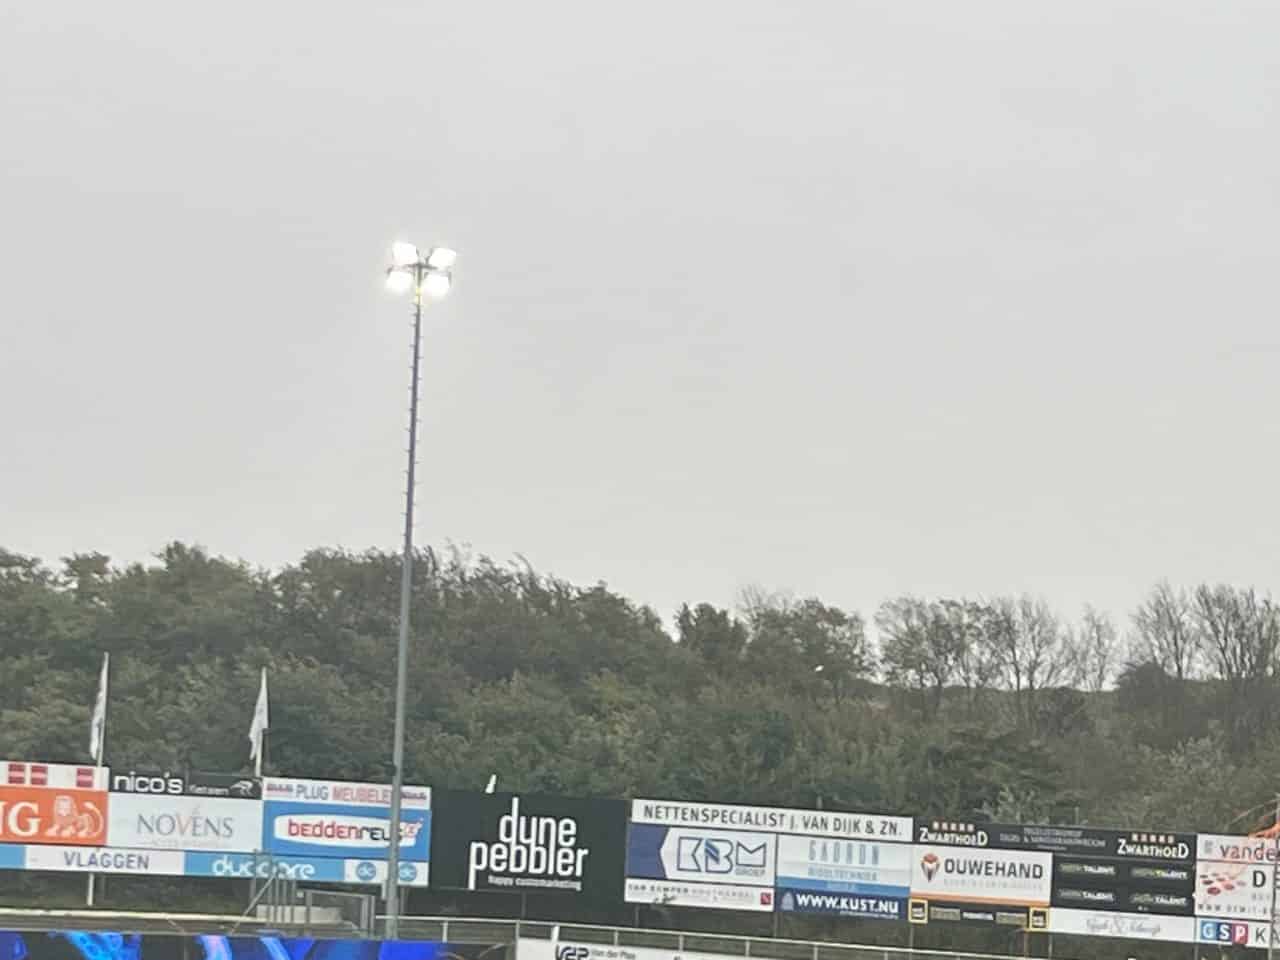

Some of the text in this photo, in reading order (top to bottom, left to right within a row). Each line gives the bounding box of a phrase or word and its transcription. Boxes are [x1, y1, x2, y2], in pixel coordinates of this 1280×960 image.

[114, 771, 183, 793] nico's
[332, 785, 397, 805] MEUBELE
[499, 797, 577, 847] dune
[643, 804, 786, 827] NETTENSPECIALIST
[802, 815, 829, 831] VAN
[677, 836, 767, 874] KBM
[1116, 838, 1190, 859] ZWARTHOED
[63, 850, 150, 870] VLAGGEN
[468, 841, 589, 890] pebbler
[944, 858, 1044, 879] OUWEHAND
[795, 893, 899, 914] WWW.KUST.NU
[1202, 922, 1246, 942] GSP
